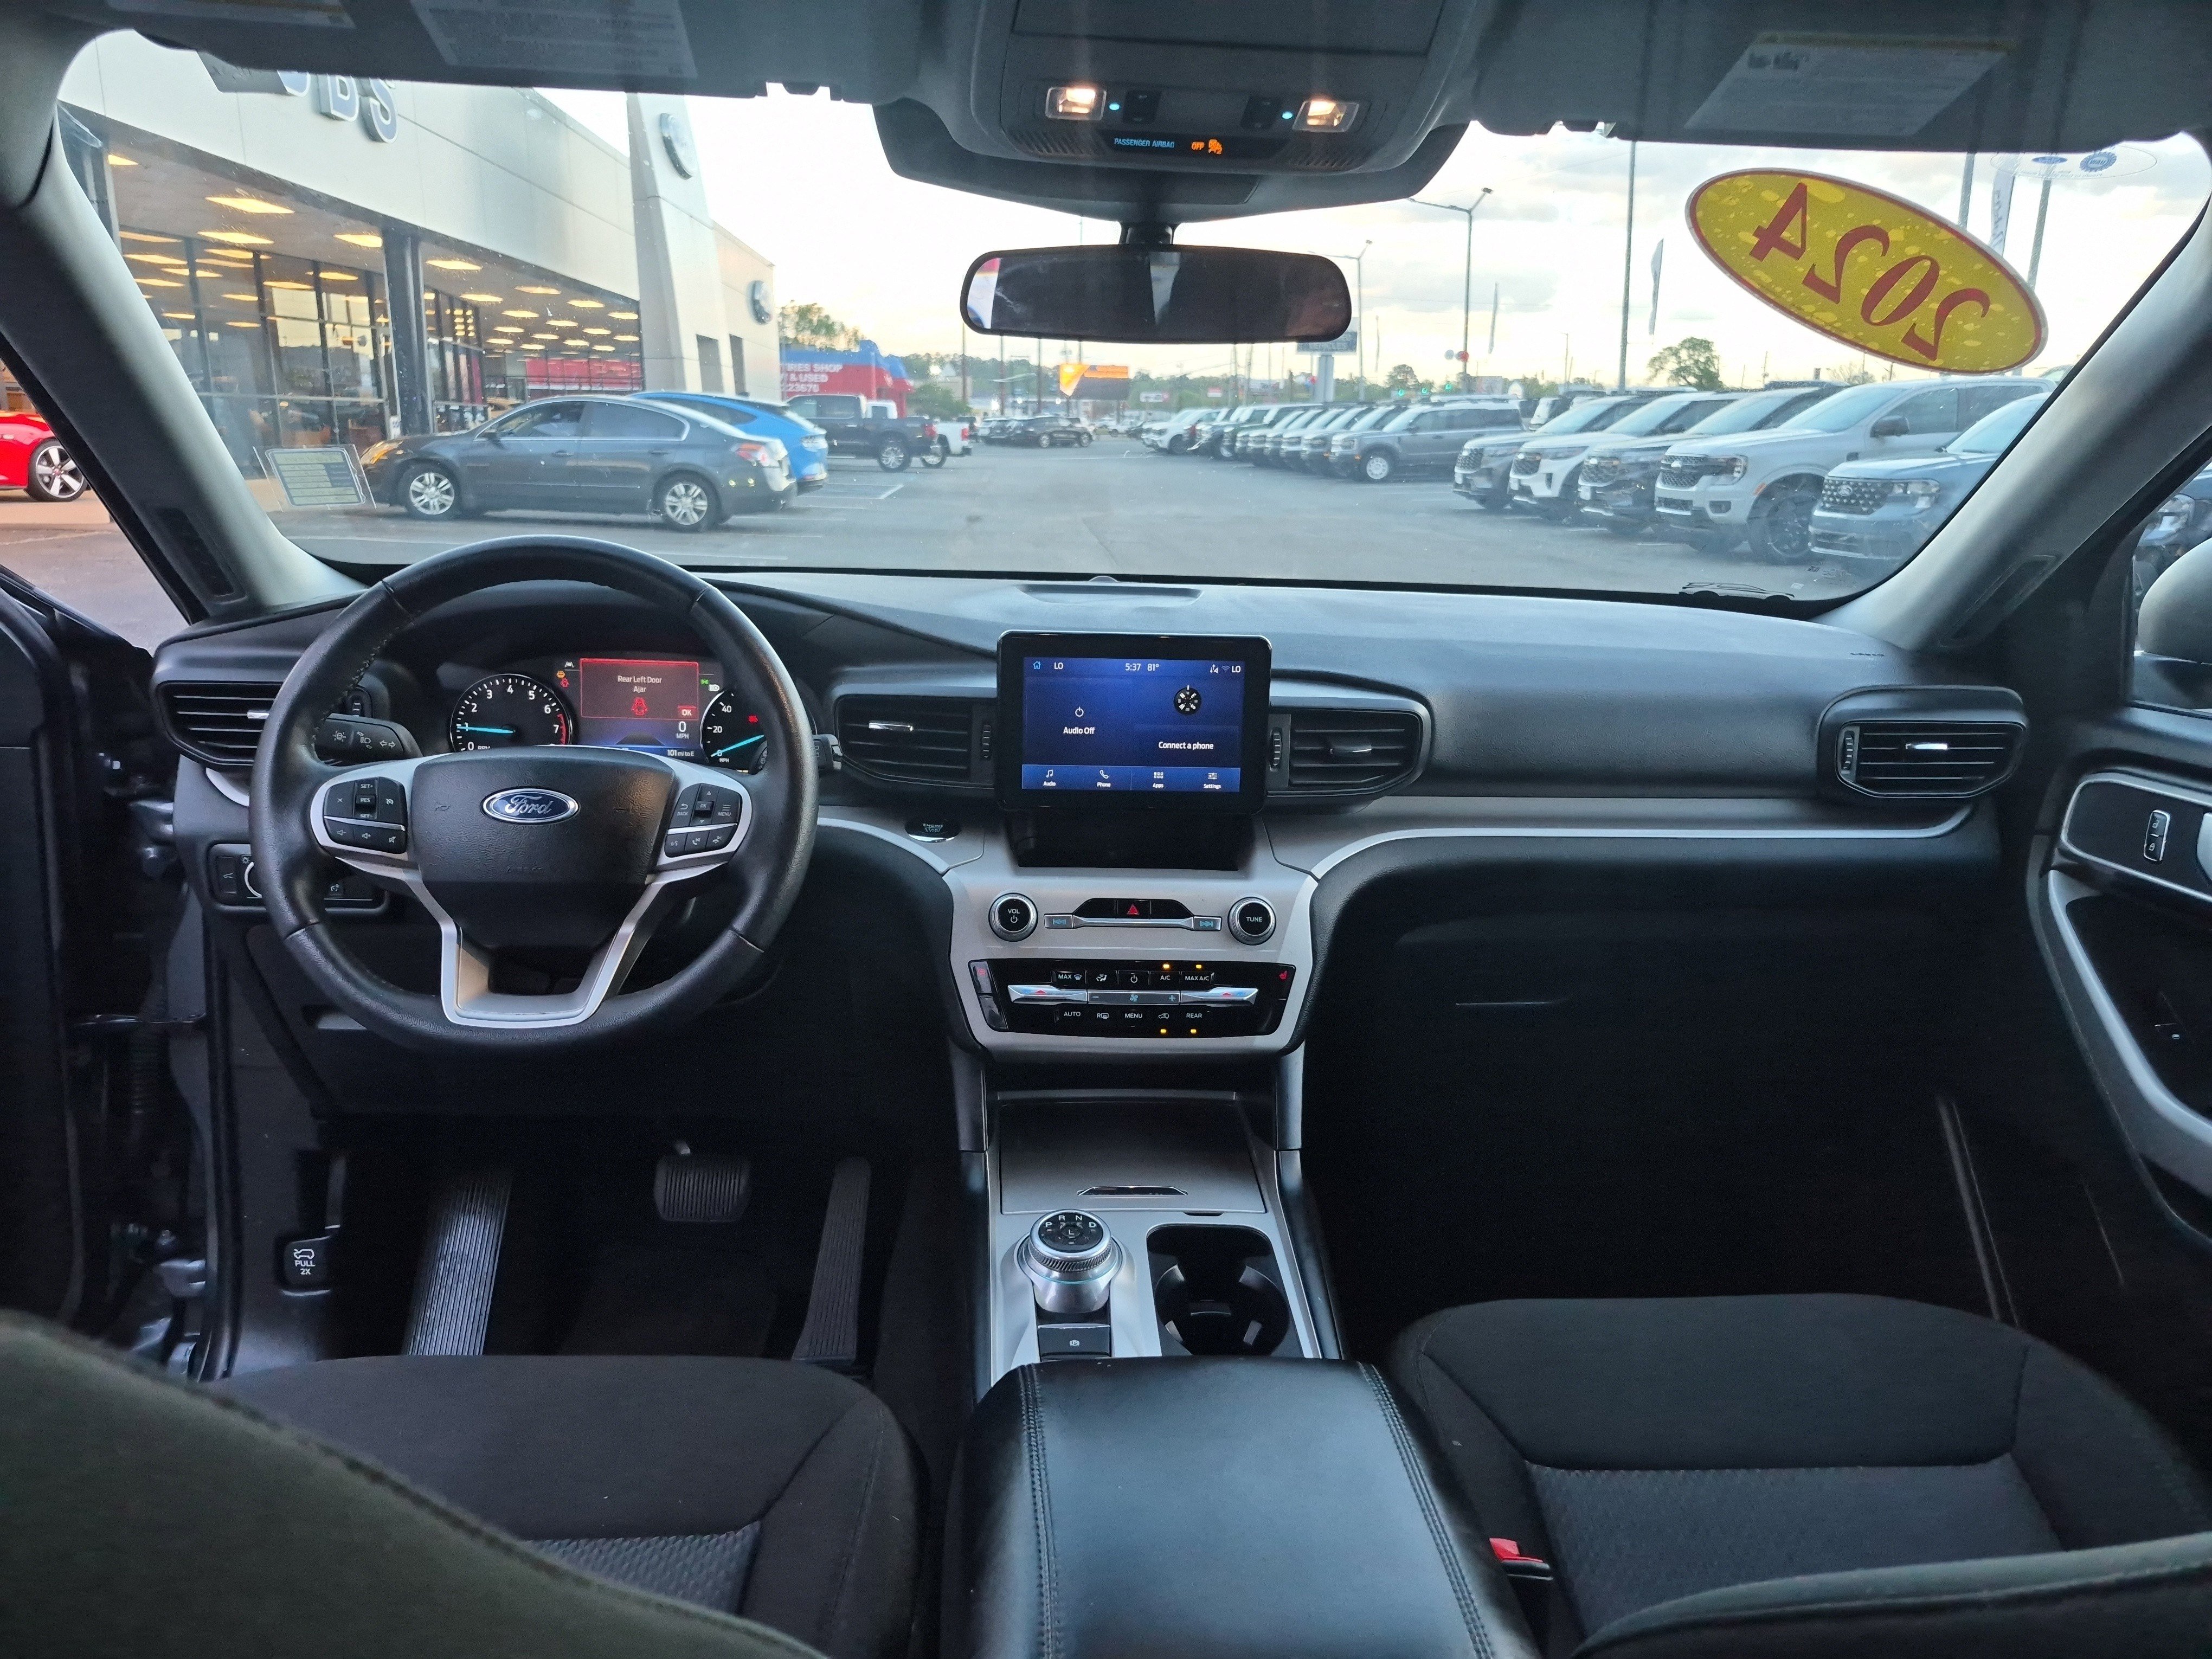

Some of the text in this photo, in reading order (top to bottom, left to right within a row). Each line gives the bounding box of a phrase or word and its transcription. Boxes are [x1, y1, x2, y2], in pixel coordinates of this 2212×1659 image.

[1114, 138, 1150, 147] PASSENGER
[1191, 142, 1205, 150] OFF
[799, 374, 828, 382] USED
[1125, 663, 1141, 671] 5:37
[507, 685, 513, 694] 4
[633, 685, 646, 693] Ajar
[487, 690, 492, 699] 3
[529, 690, 535, 700] 5
[471, 703, 478, 712] 2
[544, 705, 551, 714] 6
[553, 724, 559, 734] 7
[679, 721, 686, 732] 0
[468, 742, 474, 751] 0
[505, 795, 554, 814] Ford
